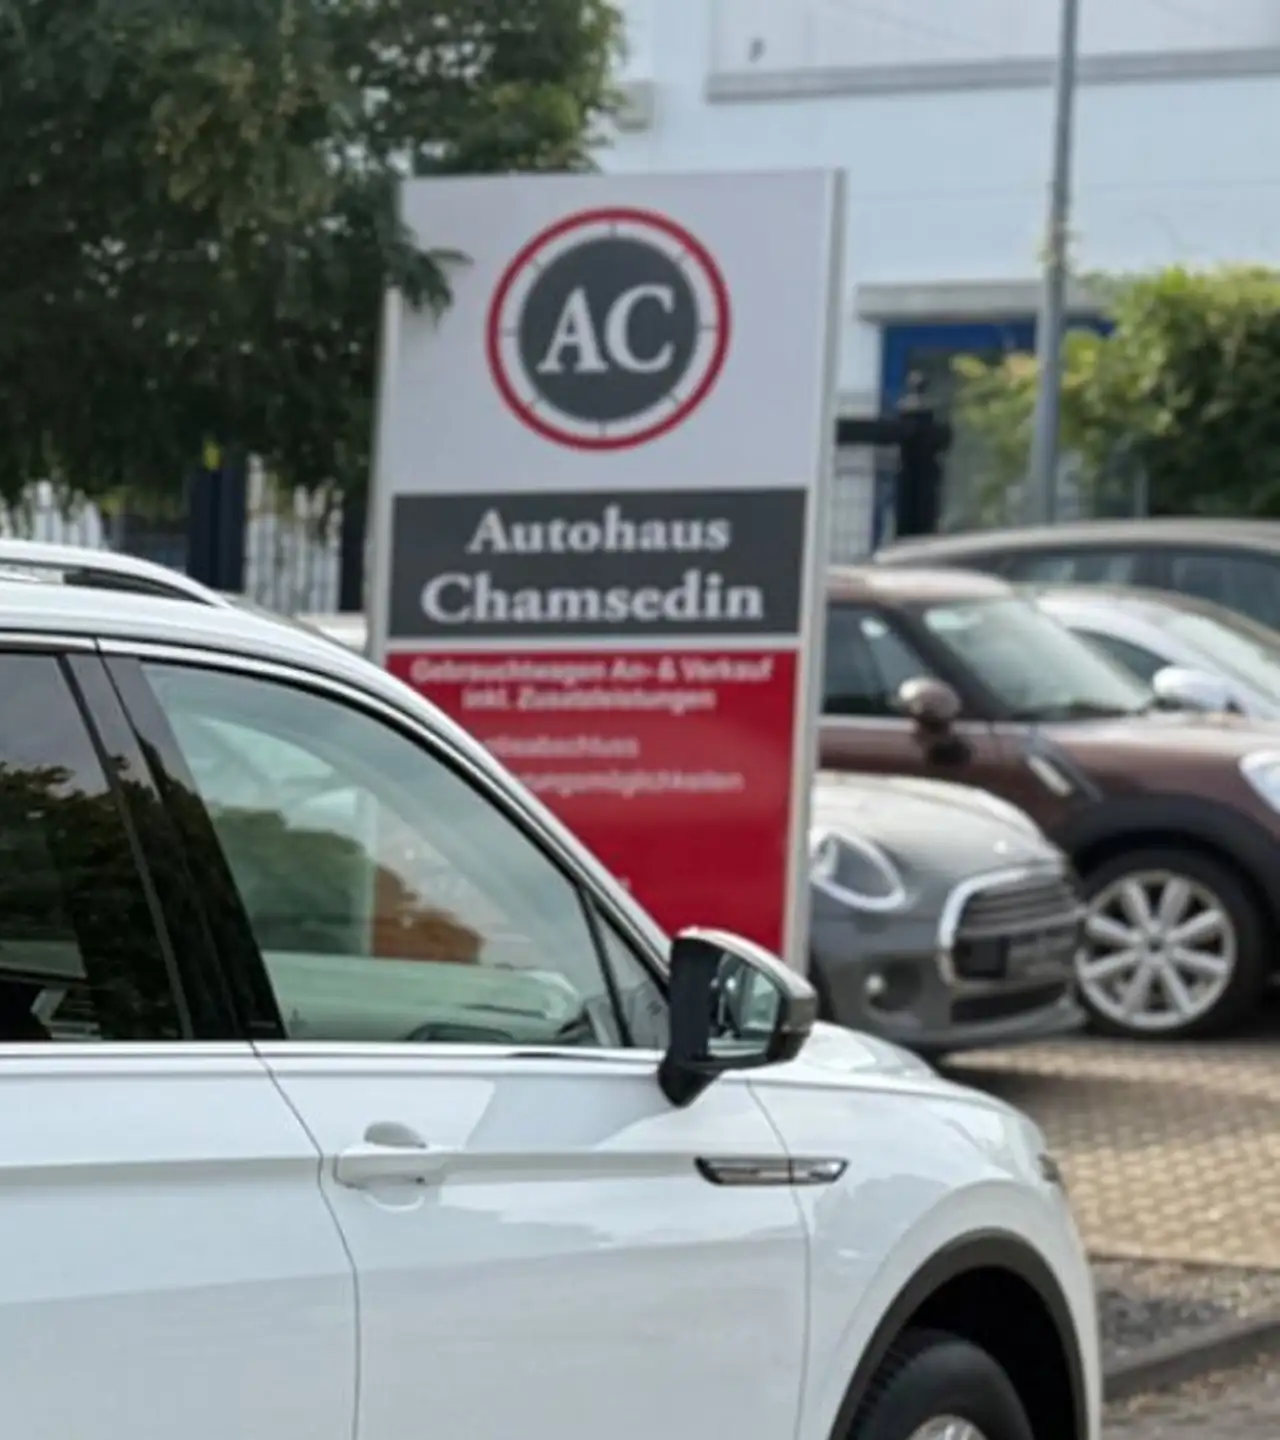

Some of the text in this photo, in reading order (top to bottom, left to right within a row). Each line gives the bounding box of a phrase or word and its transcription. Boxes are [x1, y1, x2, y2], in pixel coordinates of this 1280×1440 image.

[537, 284, 675, 374] AC
[466, 504, 732, 554] Autohaus
[420, 568, 764, 623] Chamsedin
[410, 656, 608, 688] Gebrauchtwagen
[656, 656, 677, 682] &
[680, 655, 774, 682] Verkauf
[461, 687, 717, 716] inkl. Zusatzleistungen
